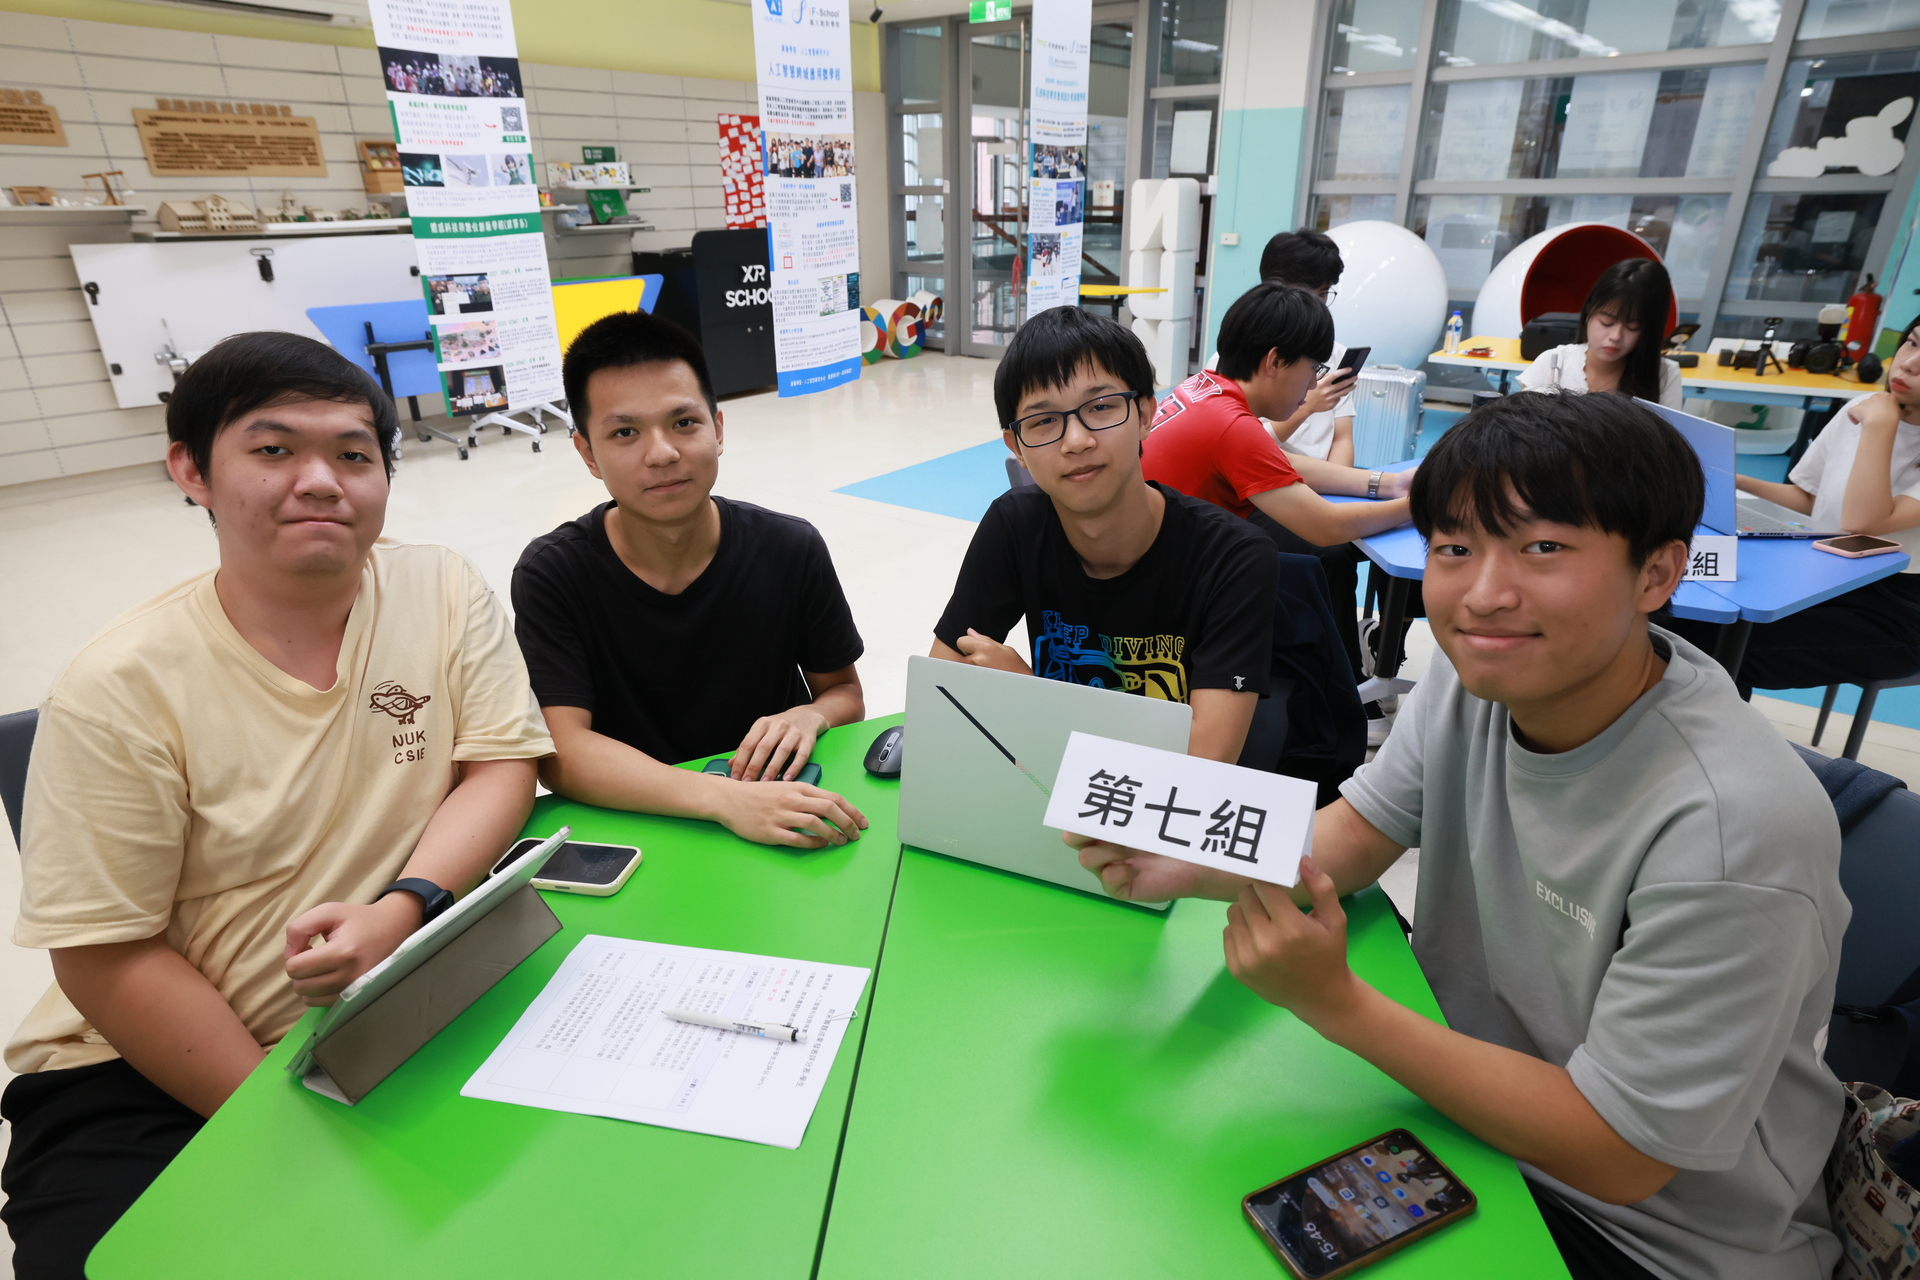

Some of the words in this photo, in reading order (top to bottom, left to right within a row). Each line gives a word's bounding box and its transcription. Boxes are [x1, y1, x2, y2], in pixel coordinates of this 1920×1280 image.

[741, 264, 766, 283] XR
[1683, 551, 1719, 577] 組
[1098, 633, 1185, 657] DIVING
[392, 730, 426, 748] NUK
[394, 747, 425, 764] CSIE
[1078, 768, 1267, 864] 第七組
[1303, 1222, 1339, 1261] 15:46
